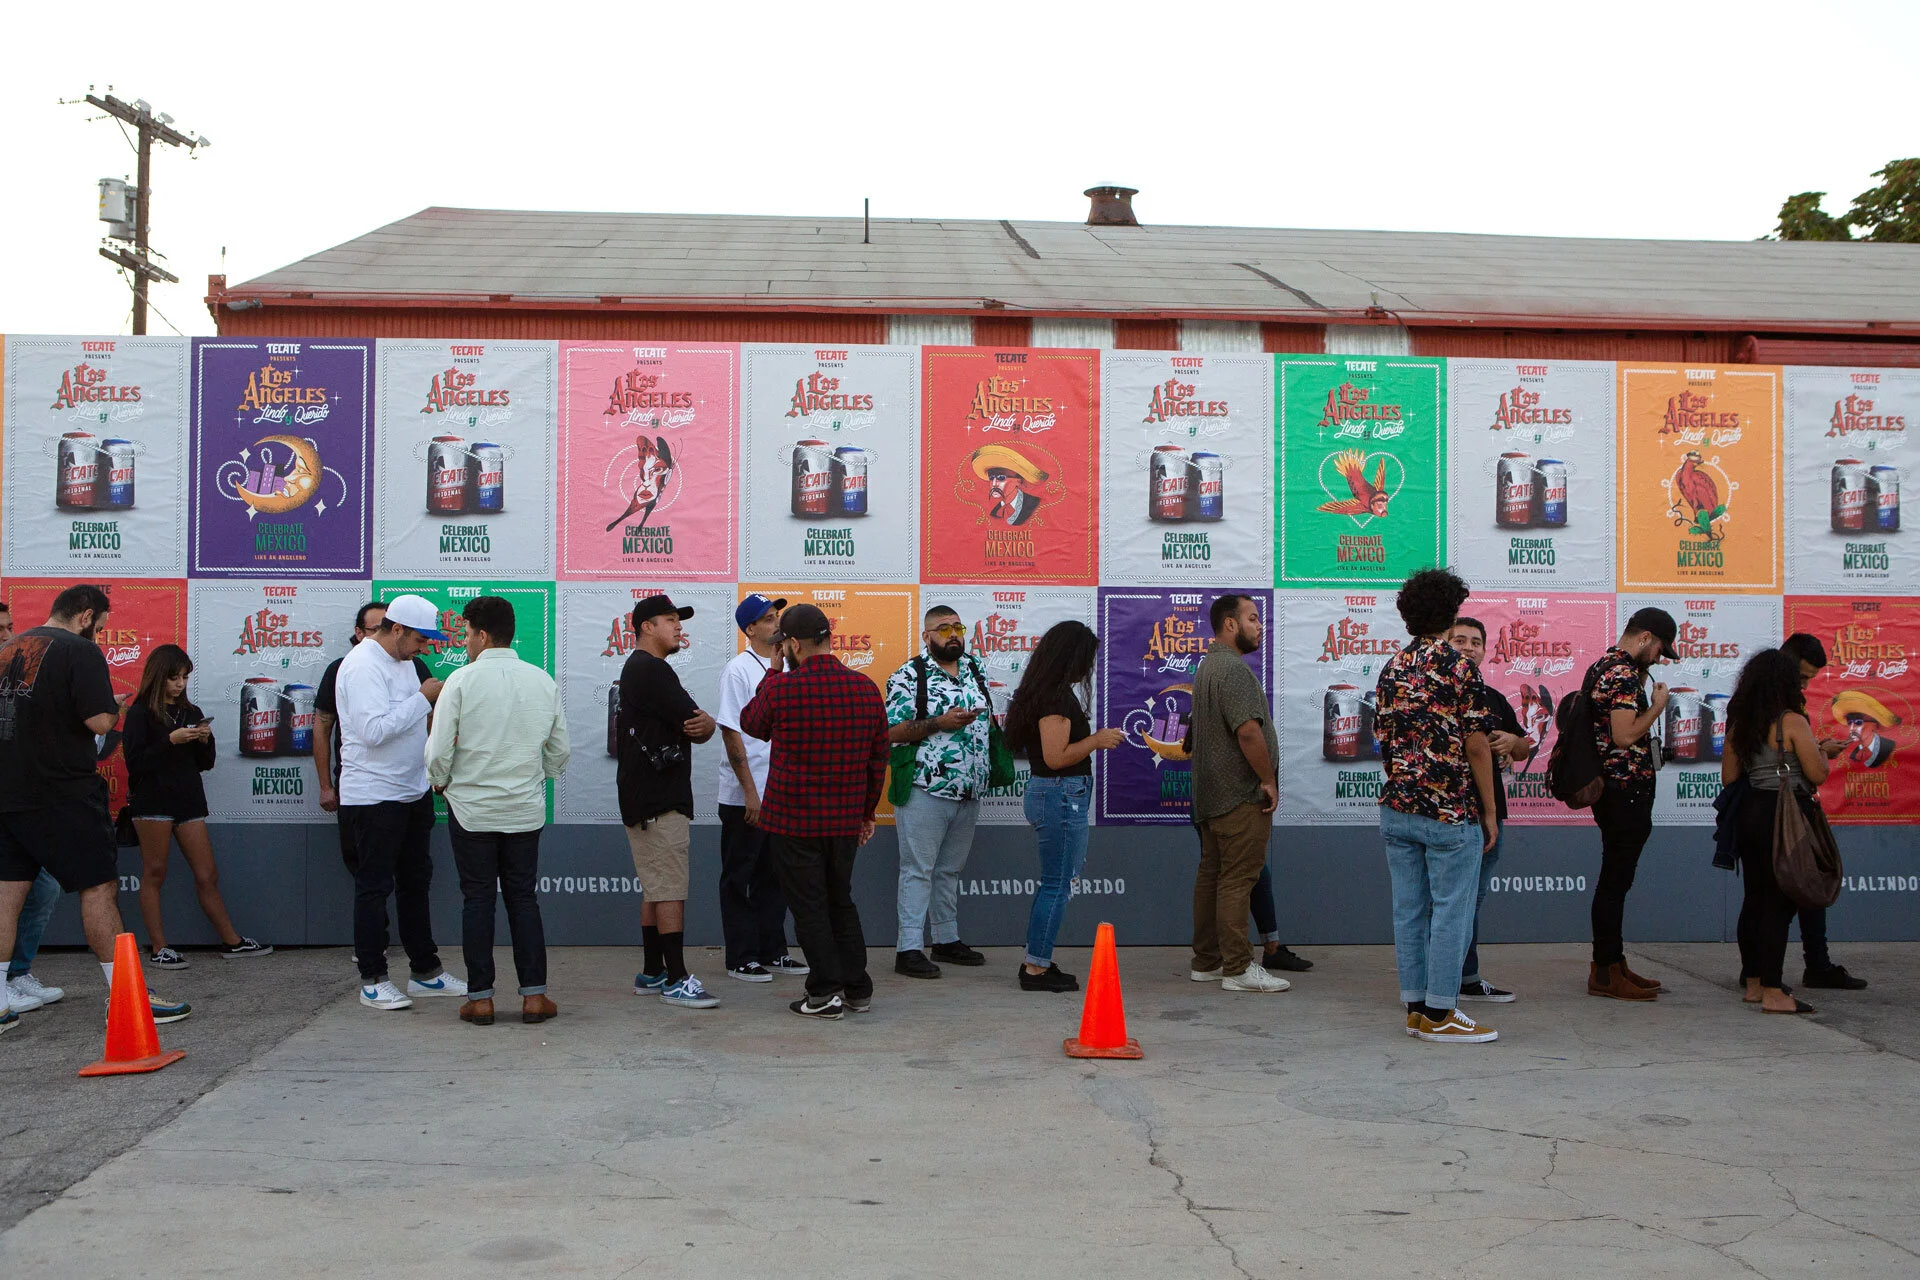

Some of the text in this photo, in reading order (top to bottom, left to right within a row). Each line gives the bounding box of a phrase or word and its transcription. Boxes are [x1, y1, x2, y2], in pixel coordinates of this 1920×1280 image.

[81, 341, 116, 352] TECATE
[266, 344, 301, 354] TECATE
[450, 345, 485, 356] TECATE
[633, 348, 667, 358] TECATE
[814, 350, 849, 361] TECATE
[994, 353, 1028, 364] TECATE
[1170, 357, 1204, 368] TECATE
[73, 362, 107, 387] Los
[1344, 361, 1377, 372] TECATE
[1516, 365, 1548, 376] TECATE
[1684, 370, 1716, 380] TECATE
[259, 364, 292, 389] Los
[443, 365, 476, 391] Los
[626, 367, 659, 393] Los
[807, 370, 840, 396] Los
[1850, 373, 1881, 384] TECATE
[987, 373, 1020, 398] Los
[1164, 377, 1196, 402] Los
[1338, 381, 1369, 406] Los
[254, 404, 289, 424] Lindo
[621, 407, 656, 427] Lindo
[982, 413, 1016, 432] Lindo
[1334, 419, 1367, 439] Lindo
[72, 521, 118, 532] CELEBRATE
[257, 522, 304, 534] CELEBRATE
[442, 524, 488, 536] CELEBRATE
[807, 527, 853, 539] CELEBRATE
[986, 529, 1032, 541] CELEBRATE
[69, 533, 121, 550] MEXICO
[254, 534, 306, 552] MEXICO
[439, 536, 491, 554] MEXICO
[1164, 531, 1208, 543] CELEBRATE
[1339, 534, 1383, 545] CELEBRATE
[622, 537, 674, 555] MEXICO
[804, 539, 855, 557] MEXICO
[984, 541, 1035, 559] MEXICO
[1161, 543, 1211, 561] MEXICO
[1336, 545, 1385, 563] MEXICO
[1508, 548, 1556, 566] MEXICO
[1677, 551, 1724, 568] MEXICO
[1843, 554, 1889, 571] MEXICO
[263, 586, 298, 597] TECATE
[446, 587, 482, 597] TECATE
[812, 590, 846, 600] TECATE
[992, 592, 1026, 602] TECATE
[1169, 594, 1203, 604] TECATE
[1344, 596, 1377, 606] TECATE
[1516, 598, 1548, 608] TECATE
[1684, 600, 1716, 610] TECATE
[255, 607, 288, 632] Los
[1163, 613, 1195, 638] Los
[1337, 616, 1369, 640] Los
[105, 645, 141, 667] Querido
[1158, 654, 1192, 673] Lindo
[255, 767, 301, 778] CELEBRATE
[1338, 770, 1381, 782] CELEBRATE
[1679, 772, 1721, 783] CELEBRATE
[252, 778, 304, 796] MEXICO
[1844, 782, 1889, 799] MEXICO
